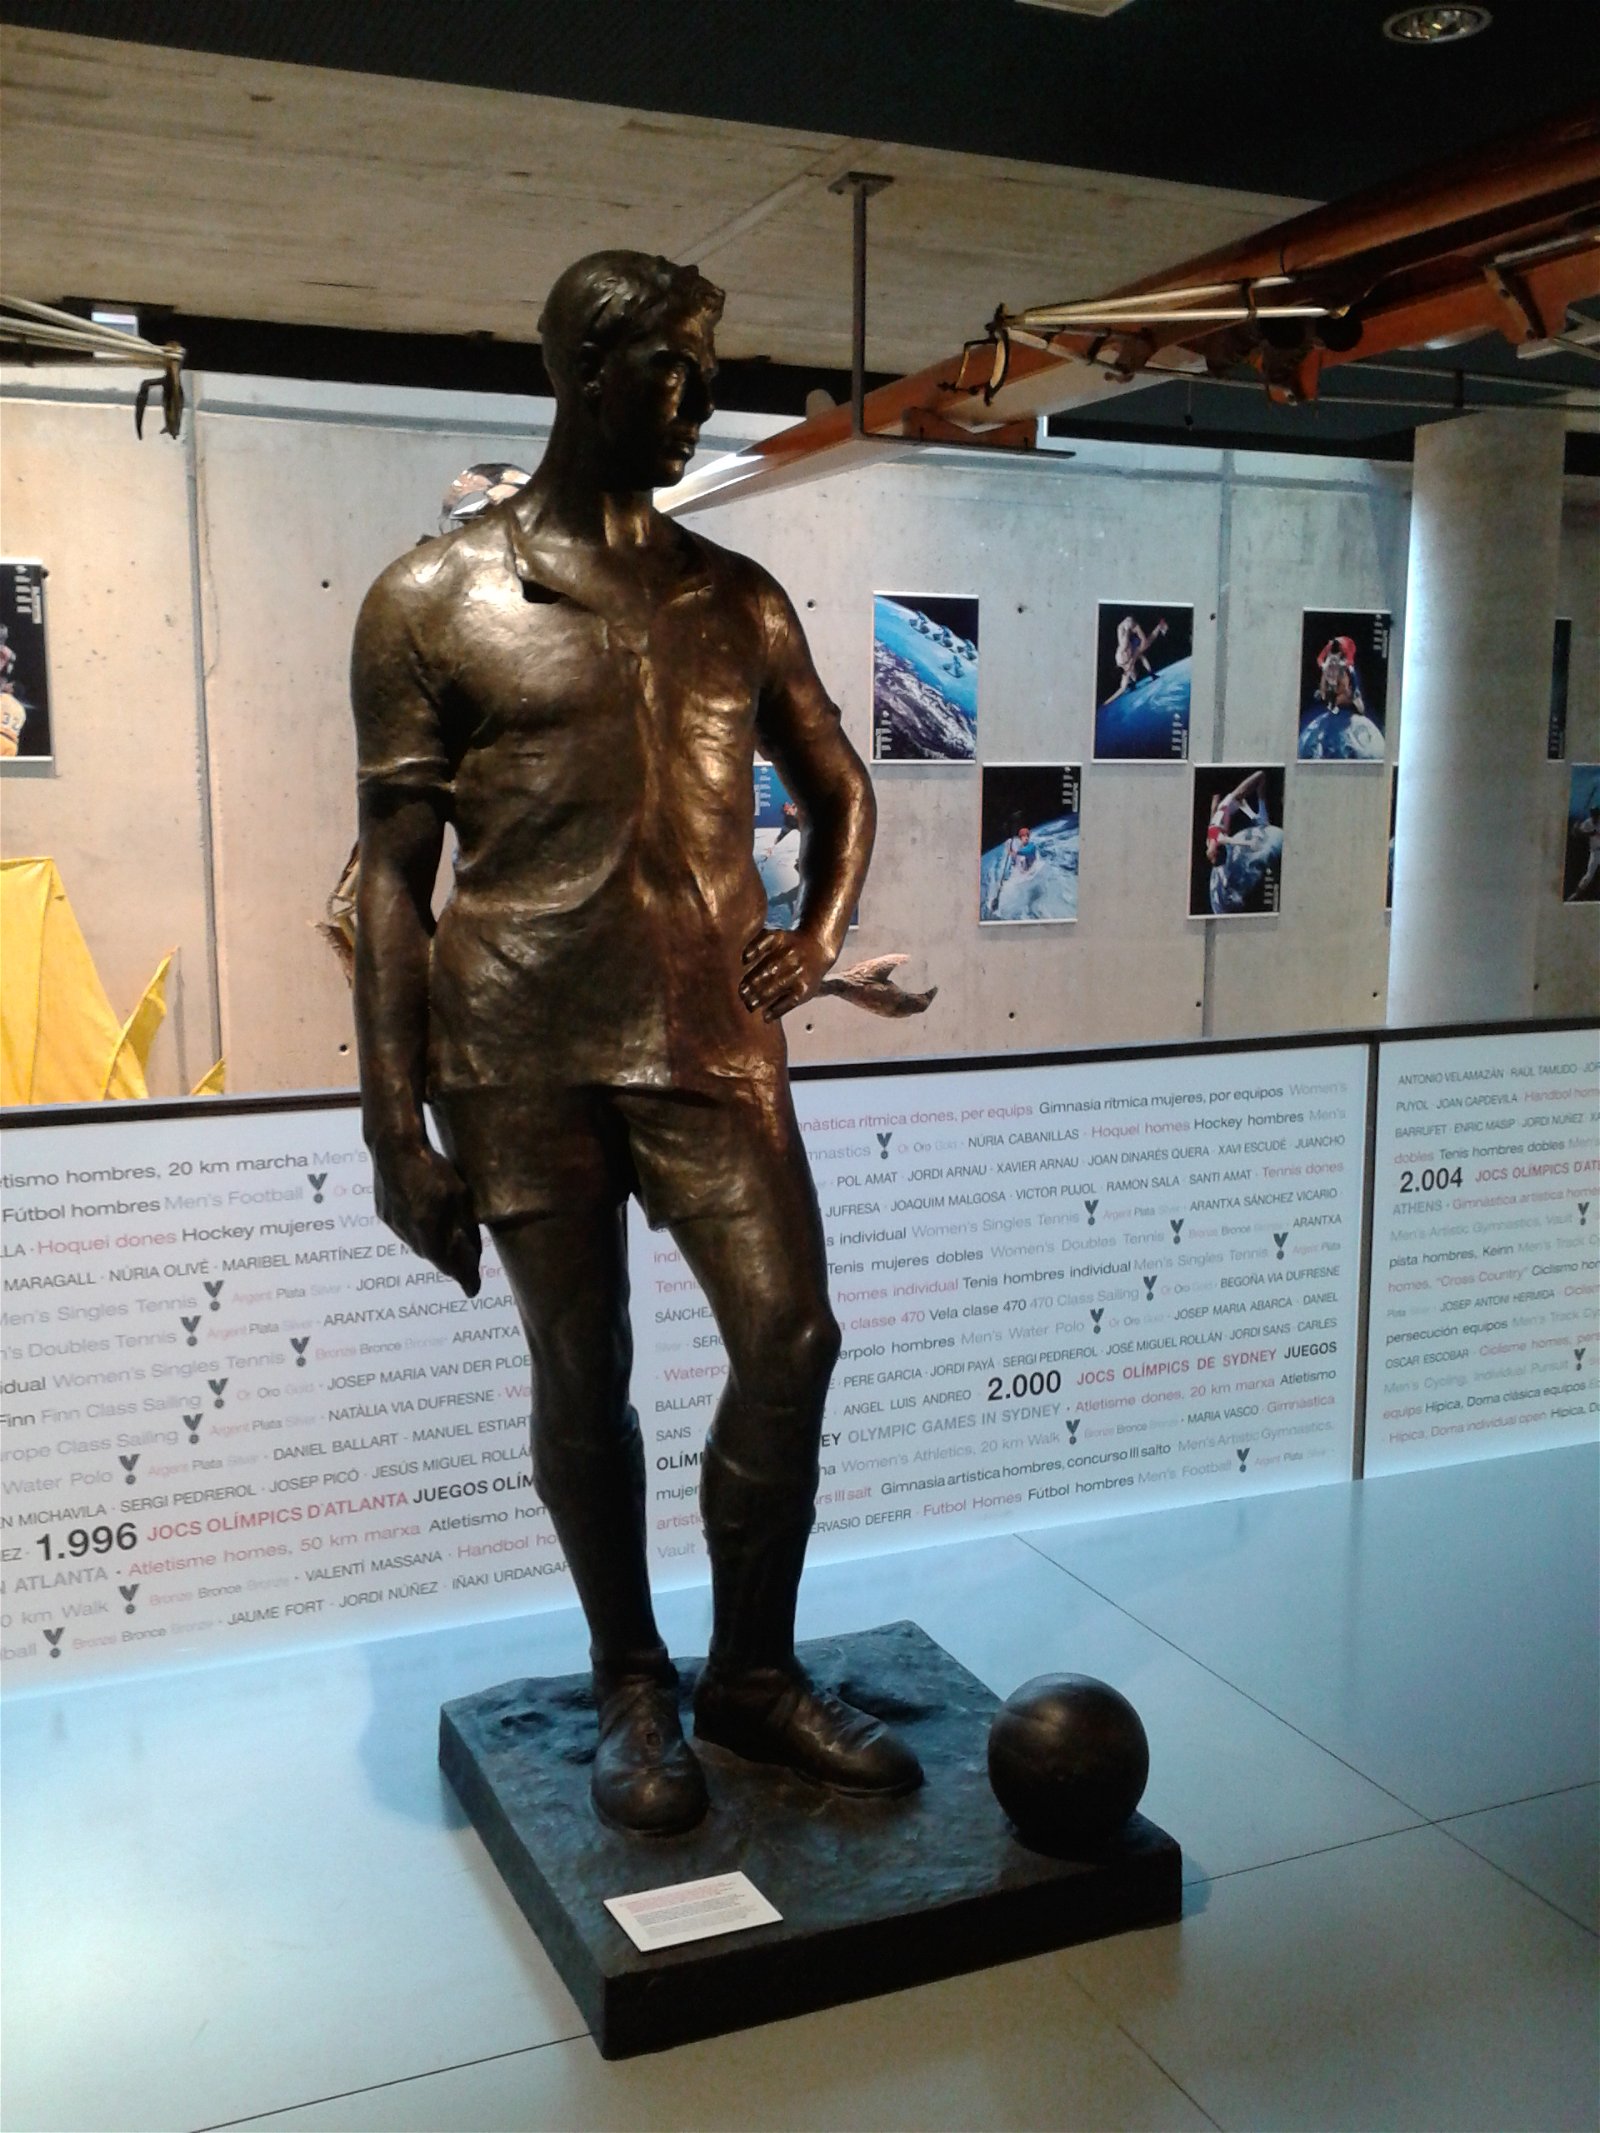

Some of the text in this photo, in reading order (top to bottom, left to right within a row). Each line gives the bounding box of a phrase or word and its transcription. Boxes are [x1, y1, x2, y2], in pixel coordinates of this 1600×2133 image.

[1399, 1072, 1443, 1085] ANTONIO
[961, 1086, 1283, 1121] per equips Gimnasia por equipos
[1008, 1112, 1303, 1145] CABANILLAS Hockey hombres
[837, 1135, 1345, 1187] POL AMAT JORDI ARNAU XAVIER ARNAU JOAN XAVI JUANCHO
[1440, 1141, 1565, 1160] Tenis hombres dobles
[66, 1154, 308, 1184] hombres, 20 km marcha
[1400, 1167, 1507, 1193] 2.004 JOCS
[826, 1161, 1343, 1217] JUFRESA JOAQUIM MALGOSA PUJOL RAMON SALA SANTI AMAT dones
[71, 1200, 160, 1218] hombres
[840, 1227, 906, 1245] individual
[1190, 1197, 1240, 1211] ARANTXA
[1296, 1188, 1337, 1201] VICARIO
[1393, 1200, 1442, 1216] ATHENS
[38, 1237, 110, 1255] Hoquei
[115, 1230, 176, 1248] dones
[182, 1224, 254, 1241] Hockey
[260, 1216, 335, 1236] mujeres
[828, 1214, 1341, 1274] Tenis mujeres dobles ARANTXA
[5, 1273, 96, 1291] MARAGALL
[222, 1254, 289, 1271] MARIBEL
[377, 1245, 396, 1257] DE
[1389, 1255, 1417, 1270] pista
[356, 1275, 400, 1292] JORDI
[837, 1261, 1131, 1303] homes individual Tenis hombres individual
[851, 1266, 1340, 1330] classe 470 Vela clase 470 DUFRESNE
[323, 1309, 394, 1327] ARANTXA
[453, 1327, 520, 1343] ARANTXA
[891, 1337, 955, 1354] hombres
[1174, 1306, 1208, 1320] JOSEP
[1213, 1303, 1246, 1316] MARIA
[1250, 1298, 1292, 1312] ABARCA
[1303, 1292, 1337, 1306] DANIEL
[1463, 1321, 1508, 1335] equipos
[844, 1318, 1337, 1387] PERE GARCIA JORDI SERGI PEDREROL MIGUEL JORDI SANS CARLES
[327, 1373, 374, 1390] JOSEP
[380, 1368, 425, 1384] MARIA
[430, 1364, 458, 1377] VAN
[463, 1360, 491, 1373] DER
[891, 1397, 916, 1409] LUIS
[923, 1390, 972, 1405] ANDREO
[987, 1370, 1061, 1401] 2.000
[1077, 1369, 1114, 1386] JOCS
[1197, 1357, 1215, 1370] DE
[1223, 1350, 1276, 1368] SYDNEY
[1284, 1342, 1337, 1360] JUEGOS
[1544, 1382, 1586, 1396] equipos
[417, 1390, 494, 1409] DUFRESNE
[655, 1395, 712, 1412] BALLART
[848, 1424, 916, 1443] OLYMPIC
[923, 1415, 976, 1433] GAMES
[982, 1413, 996, 1424] IN
[1002, 1404, 1061, 1422] SYDNEY
[1075, 1395, 1136, 1413] Atletisme
[1191, 1386, 1206, 1397] 20
[1211, 1382, 1231, 1394] km
[1280, 1370, 1336, 1386] Atletismo
[1224, 1406, 1259, 1419] VASCO
[274, 1444, 326, 1460] DANIEL
[333, 1433, 398, 1451] BALLART
[412, 1426, 473, 1442] MANUEL
[656, 1428, 691, 1442] SANS
[881, 1443, 1171, 1495] Gimnasia hombres, concurso salto
[19, 1455, 478, 1526] MICHAVILA SERGI PEDREROL JOSEP MIGUEL
[866, 1475, 1134, 1526] DEFERR Homes hombres
[36, 1522, 137, 1561] 1.996
[147, 1521, 201, 1542] JOCS
[412, 1480, 487, 1503] JUEGOS
[15, 1510, 507, 1594] ATLANTA Atletisme 50 km Atletismo
[371, 1552, 441, 1572] MASSANA
[457, 1538, 529, 1558] Handbol
[228, 1607, 279, 1625] JAUME
[285, 1601, 323, 1616] FORT
[339, 1592, 383, 1608] JORDI
